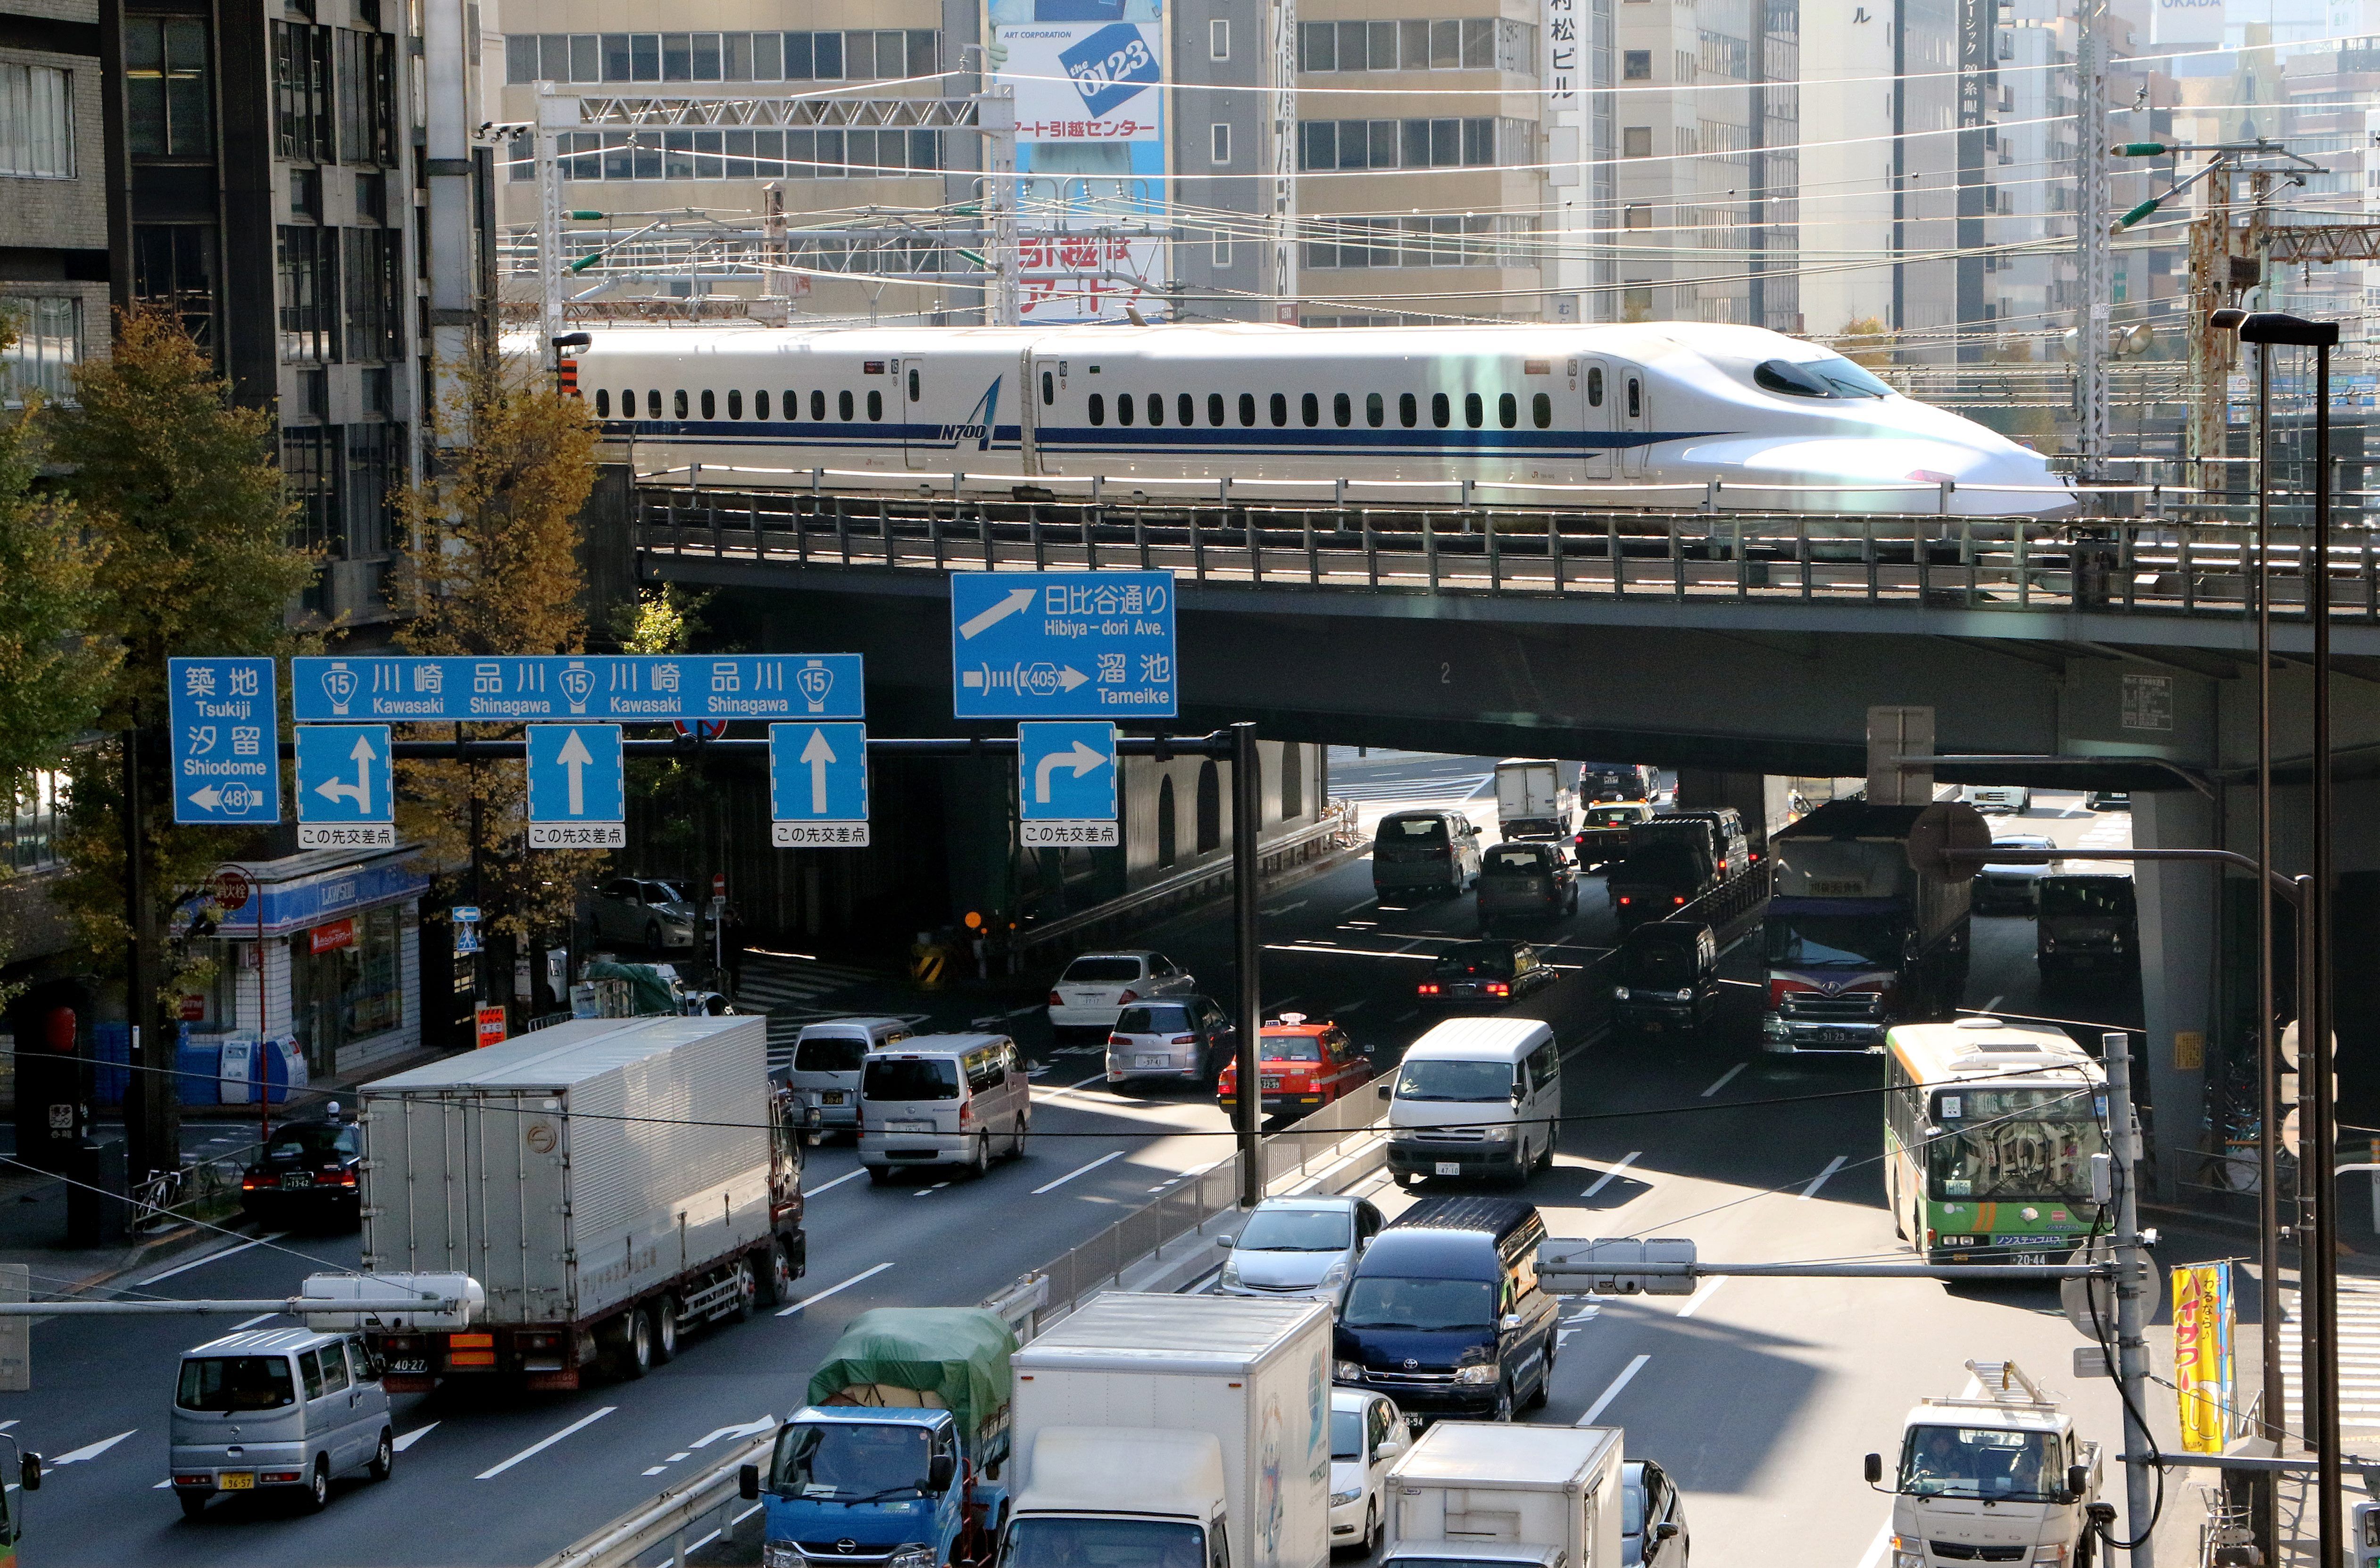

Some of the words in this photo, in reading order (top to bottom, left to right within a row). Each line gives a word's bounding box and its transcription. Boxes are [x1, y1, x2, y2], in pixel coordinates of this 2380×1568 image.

[1070, 60, 1089, 76] the
[1077, 40, 1149, 97] 0123
[1014, 119, 1154, 137] アート引越センター
[892, 361, 898, 372] 15
[1061, 363, 1066, 375] 16
[1569, 361, 1576, 374] 16
[941, 424, 987, 440] N700
[1045, 585, 1167, 615] 日比谷通り
[1134, 621, 1165, 635] Ave.
[1097, 654, 1170, 683] 溜池
[1441, 662, 1450, 684] 2
[186, 666, 258, 697] 築地
[328, 676, 350, 695] 15
[373, 663, 444, 694] 川崎
[474, 664, 544, 692] 品川
[565, 674, 587, 693] 15
[610, 663, 681, 692] 川崎
[711, 662, 782, 692] 品川
[804, 673, 825, 692] 15
[1030, 671, 1055, 687] 405
[1097, 688, 1169, 704] Tameike
[195, 700, 251, 721] Tsukiji
[373, 697, 444, 714] Kawasaki
[470, 697, 550, 717] Shinagawa
[610, 697, 681, 713] Kawasaki
[707, 696, 788, 715] Shinagawa
[189, 726, 260, 755] 汐留
[183, 759, 266, 776] Shiodome
[224, 790, 248, 807] 481
[303, 829, 391, 845] この先交差点
[533, 828, 622, 843] この先交差点
[777, 828, 865, 843] この先交差点
[1025, 827, 1115, 841] この先交差点
[322, 881, 356, 906] LAWSON
[1997, 1235, 2063, 1245] ノンステップバス
[2016, 1254, 2046, 1265] 20-44
[2176, 1273, 2201, 1392] ハイサワー
[394, 1359, 425, 1371] 40-27
[228, 1479, 252, 1490] 96-57
